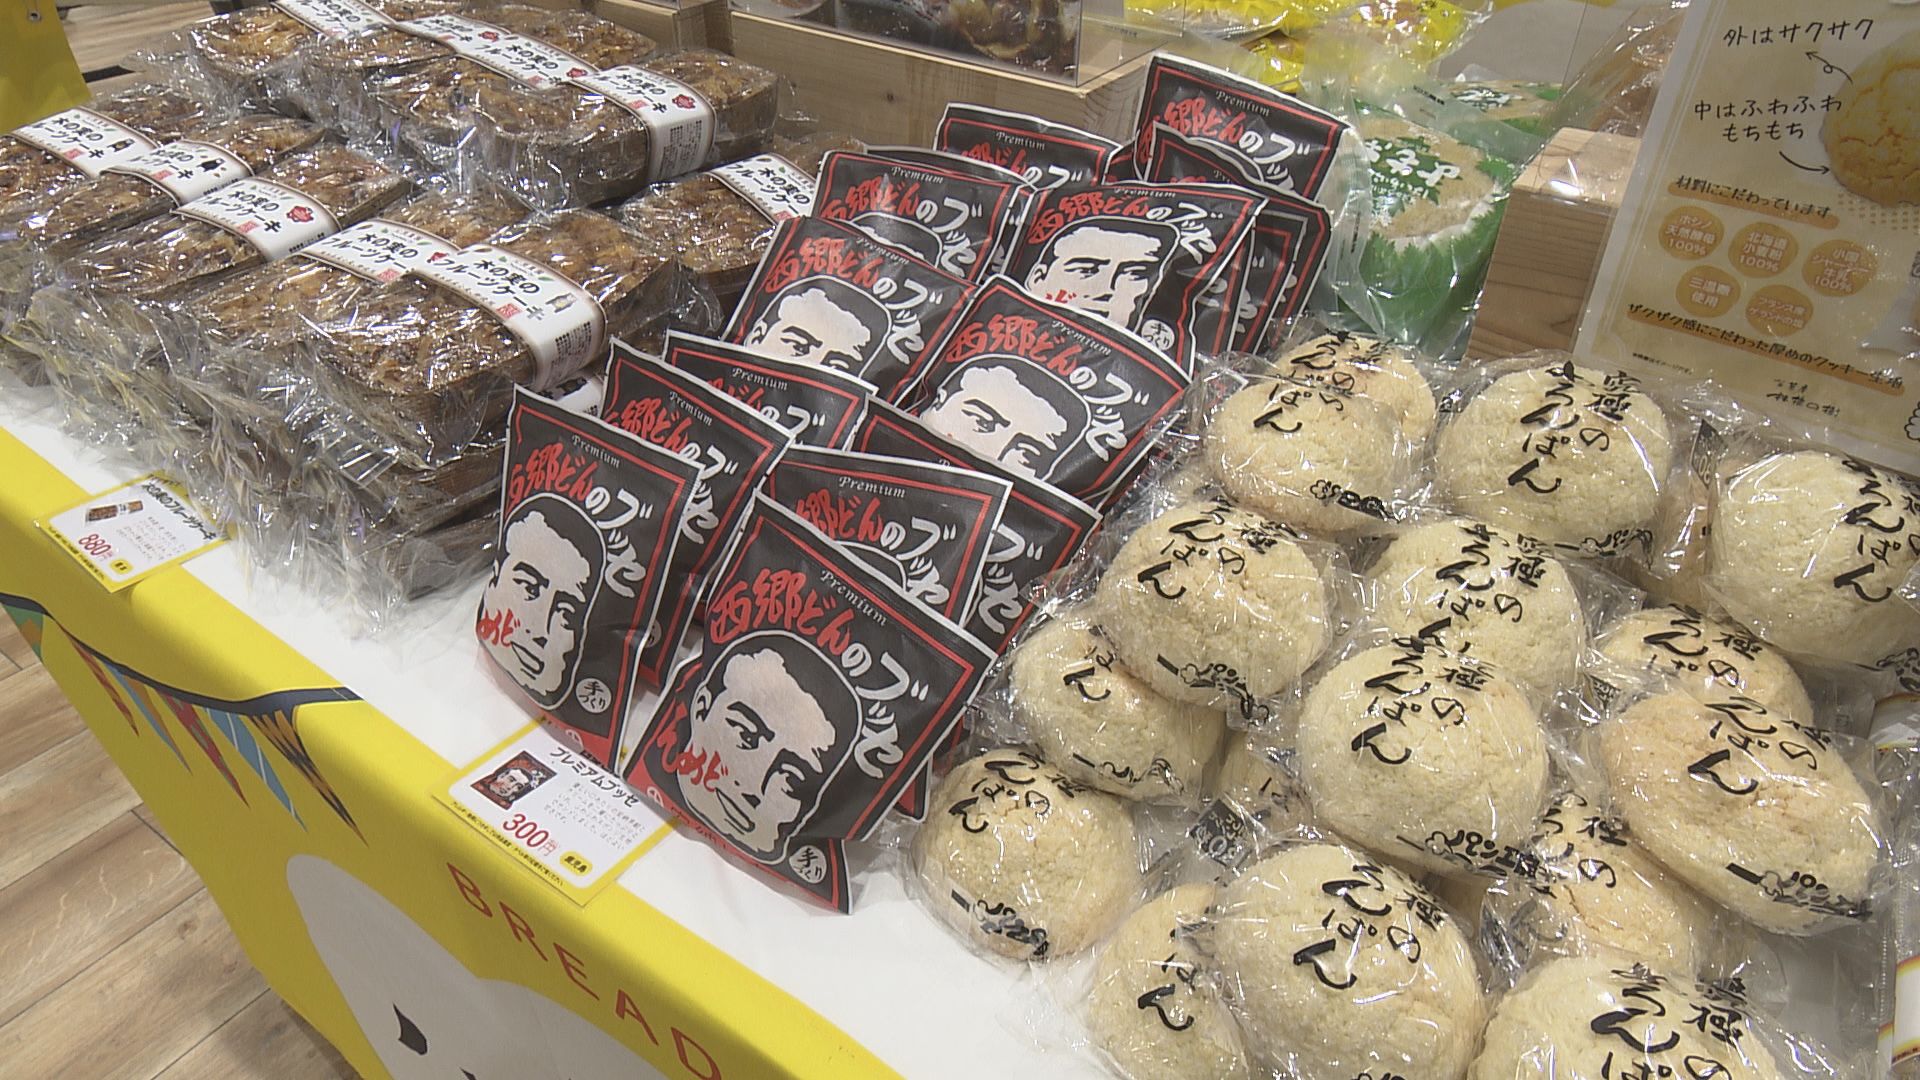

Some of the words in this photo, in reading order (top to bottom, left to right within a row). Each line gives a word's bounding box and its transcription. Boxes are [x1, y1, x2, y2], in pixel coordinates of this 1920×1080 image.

[1723, 19, 1874, 47] 外はサクサク
[507, 44, 560, 70] 木の実の
[616, 73, 667, 96] 木の実の
[1216, 91, 1272, 117] Premium
[1695, 95, 1842, 121] 中はふわふわ
[53, 117, 104, 142] 木の実の
[996, 130, 1047, 151] Premium
[1723, 121, 1804, 142] もちもち
[758, 167, 811, 206] 木の実の
[891, 166, 944, 185] Premium
[228, 191, 280, 212] 木の実の
[1676, 175, 1831, 218] 材料にこだわっています
[358, 232, 418, 258] 木の実の
[1668, 237, 1707, 257] 100%
[1743, 243, 1784, 261] 小麦粉
[1749, 231, 1789, 248] 北海道
[1739, 256, 1780, 273] 100%
[434, 259, 545, 321] フルーツケーキ
[473, 260, 541, 295] 木の実の
[1815, 276, 1853, 293] 100%
[1692, 291, 1719, 308] 使用
[1052, 318, 1113, 357] Premium
[732, 367, 789, 391] Premium
[669, 390, 714, 426] Premium
[571, 433, 622, 469] Premium
[839, 475, 907, 499] Premium
[820, 569, 889, 628] Premium
[710, 567, 930, 780] 西郷どんのブッセ
[583, 680, 604, 696] 手
[796, 847, 819, 867] 手
[446, 862, 723, 1080] BREAD
